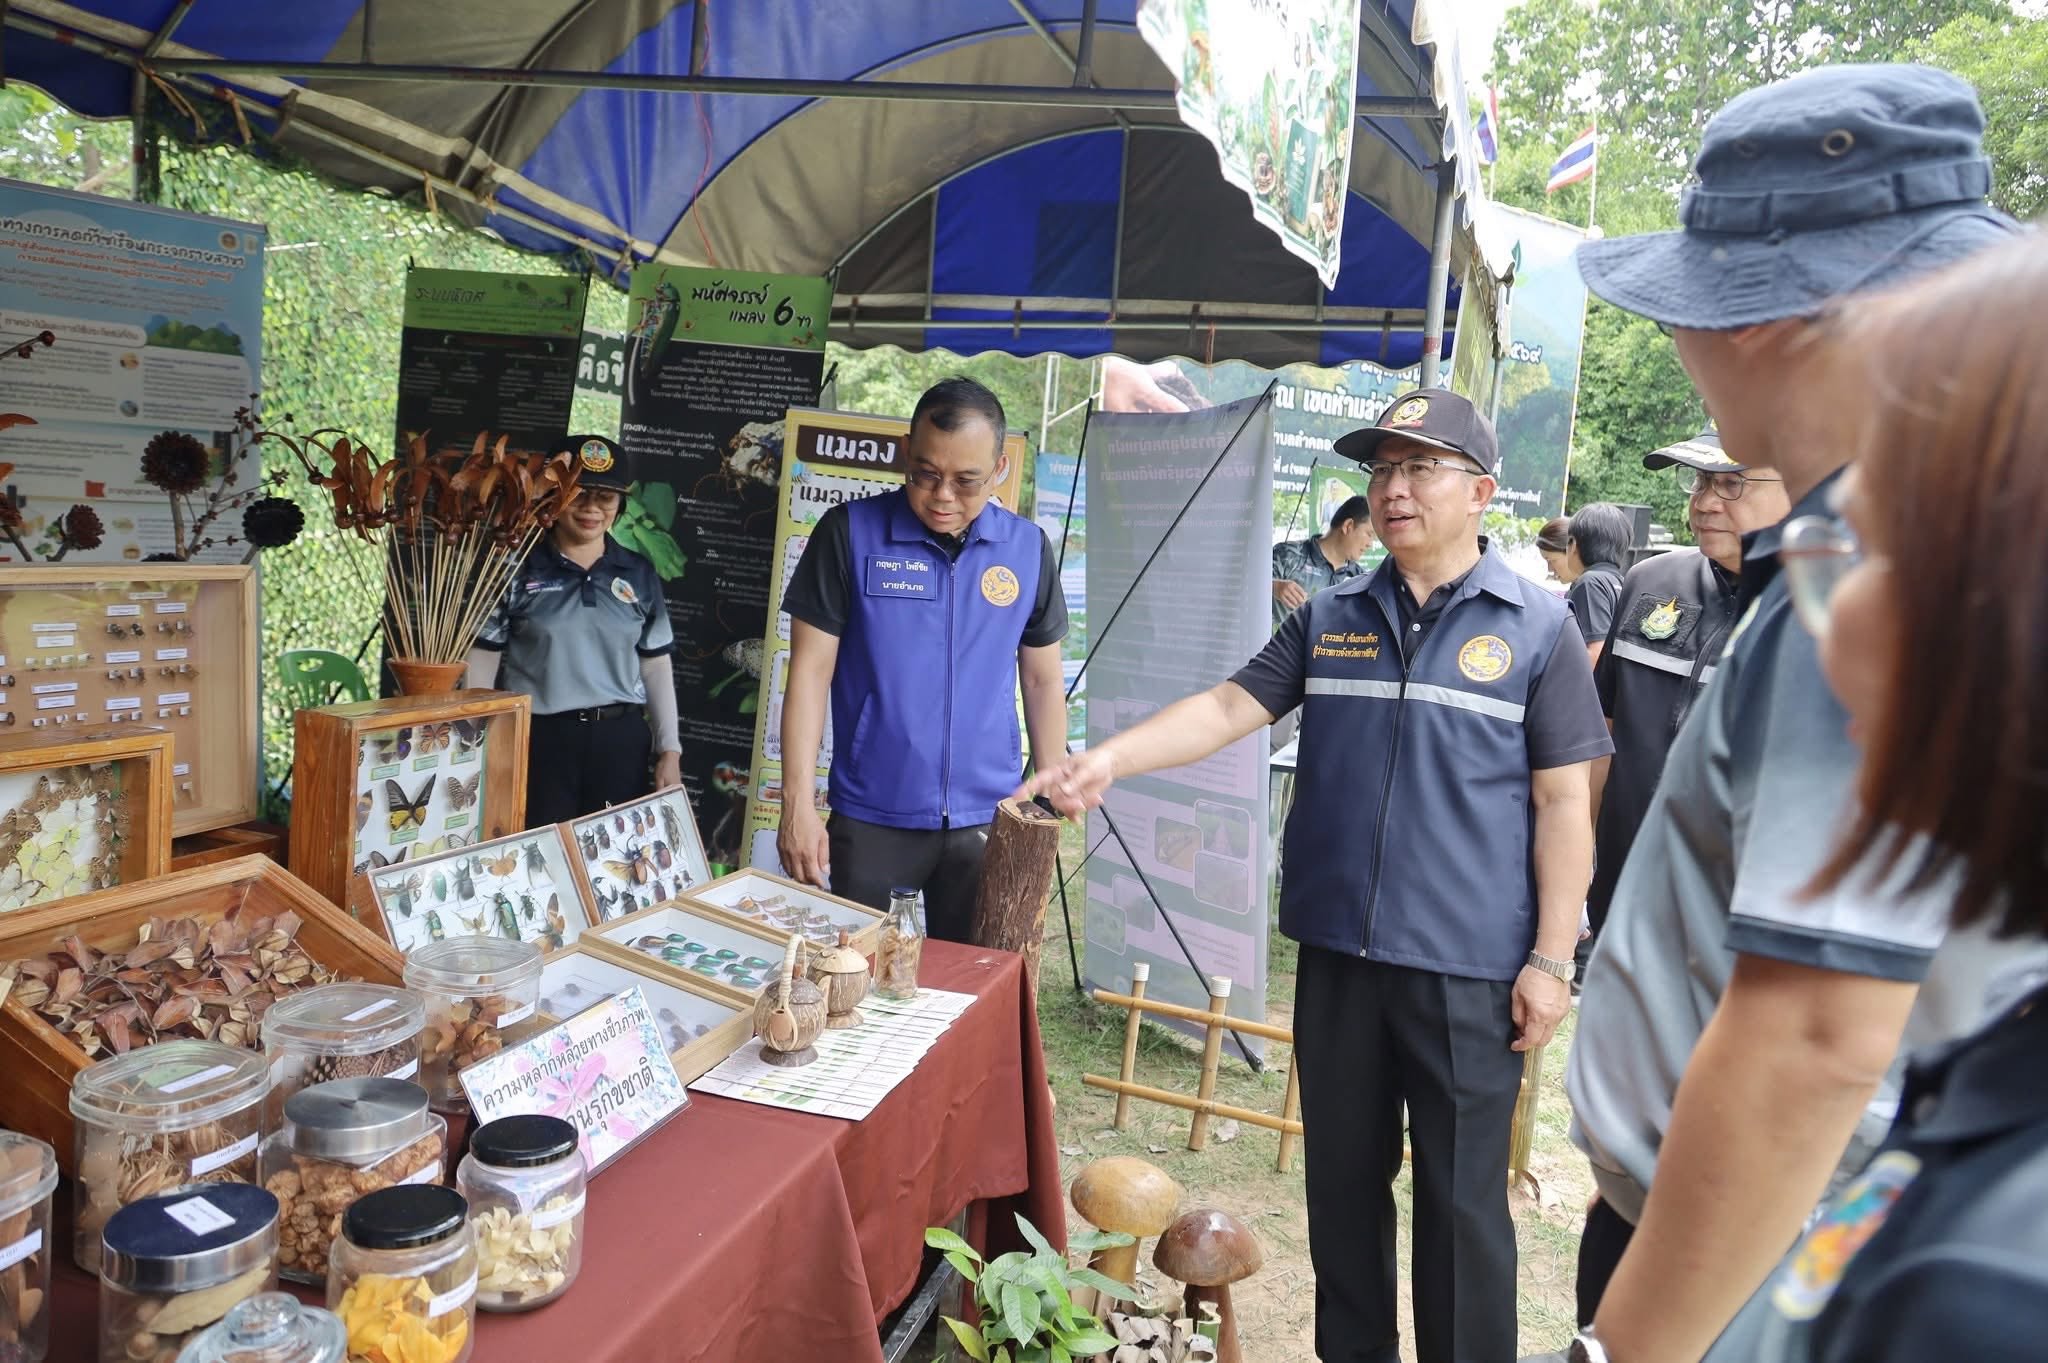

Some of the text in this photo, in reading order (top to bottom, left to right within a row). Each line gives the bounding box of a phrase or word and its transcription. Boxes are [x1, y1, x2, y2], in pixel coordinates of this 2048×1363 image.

[692, 280, 771, 304] มหัศจรรย์
[729, 296, 811, 328] แมลง 6 ขา
[1511, 343, 1543, 364] ๕๖๙
[1276, 385, 1295, 410] ณ
[816, 433, 896, 464] แมลง
[882, 580, 924, 592] นายอำเภอ
[482, 1006, 646, 1112] ความหลากหลายทางชีวภาพ
[566, 1056, 656, 1132] วนรุกขชาติ
